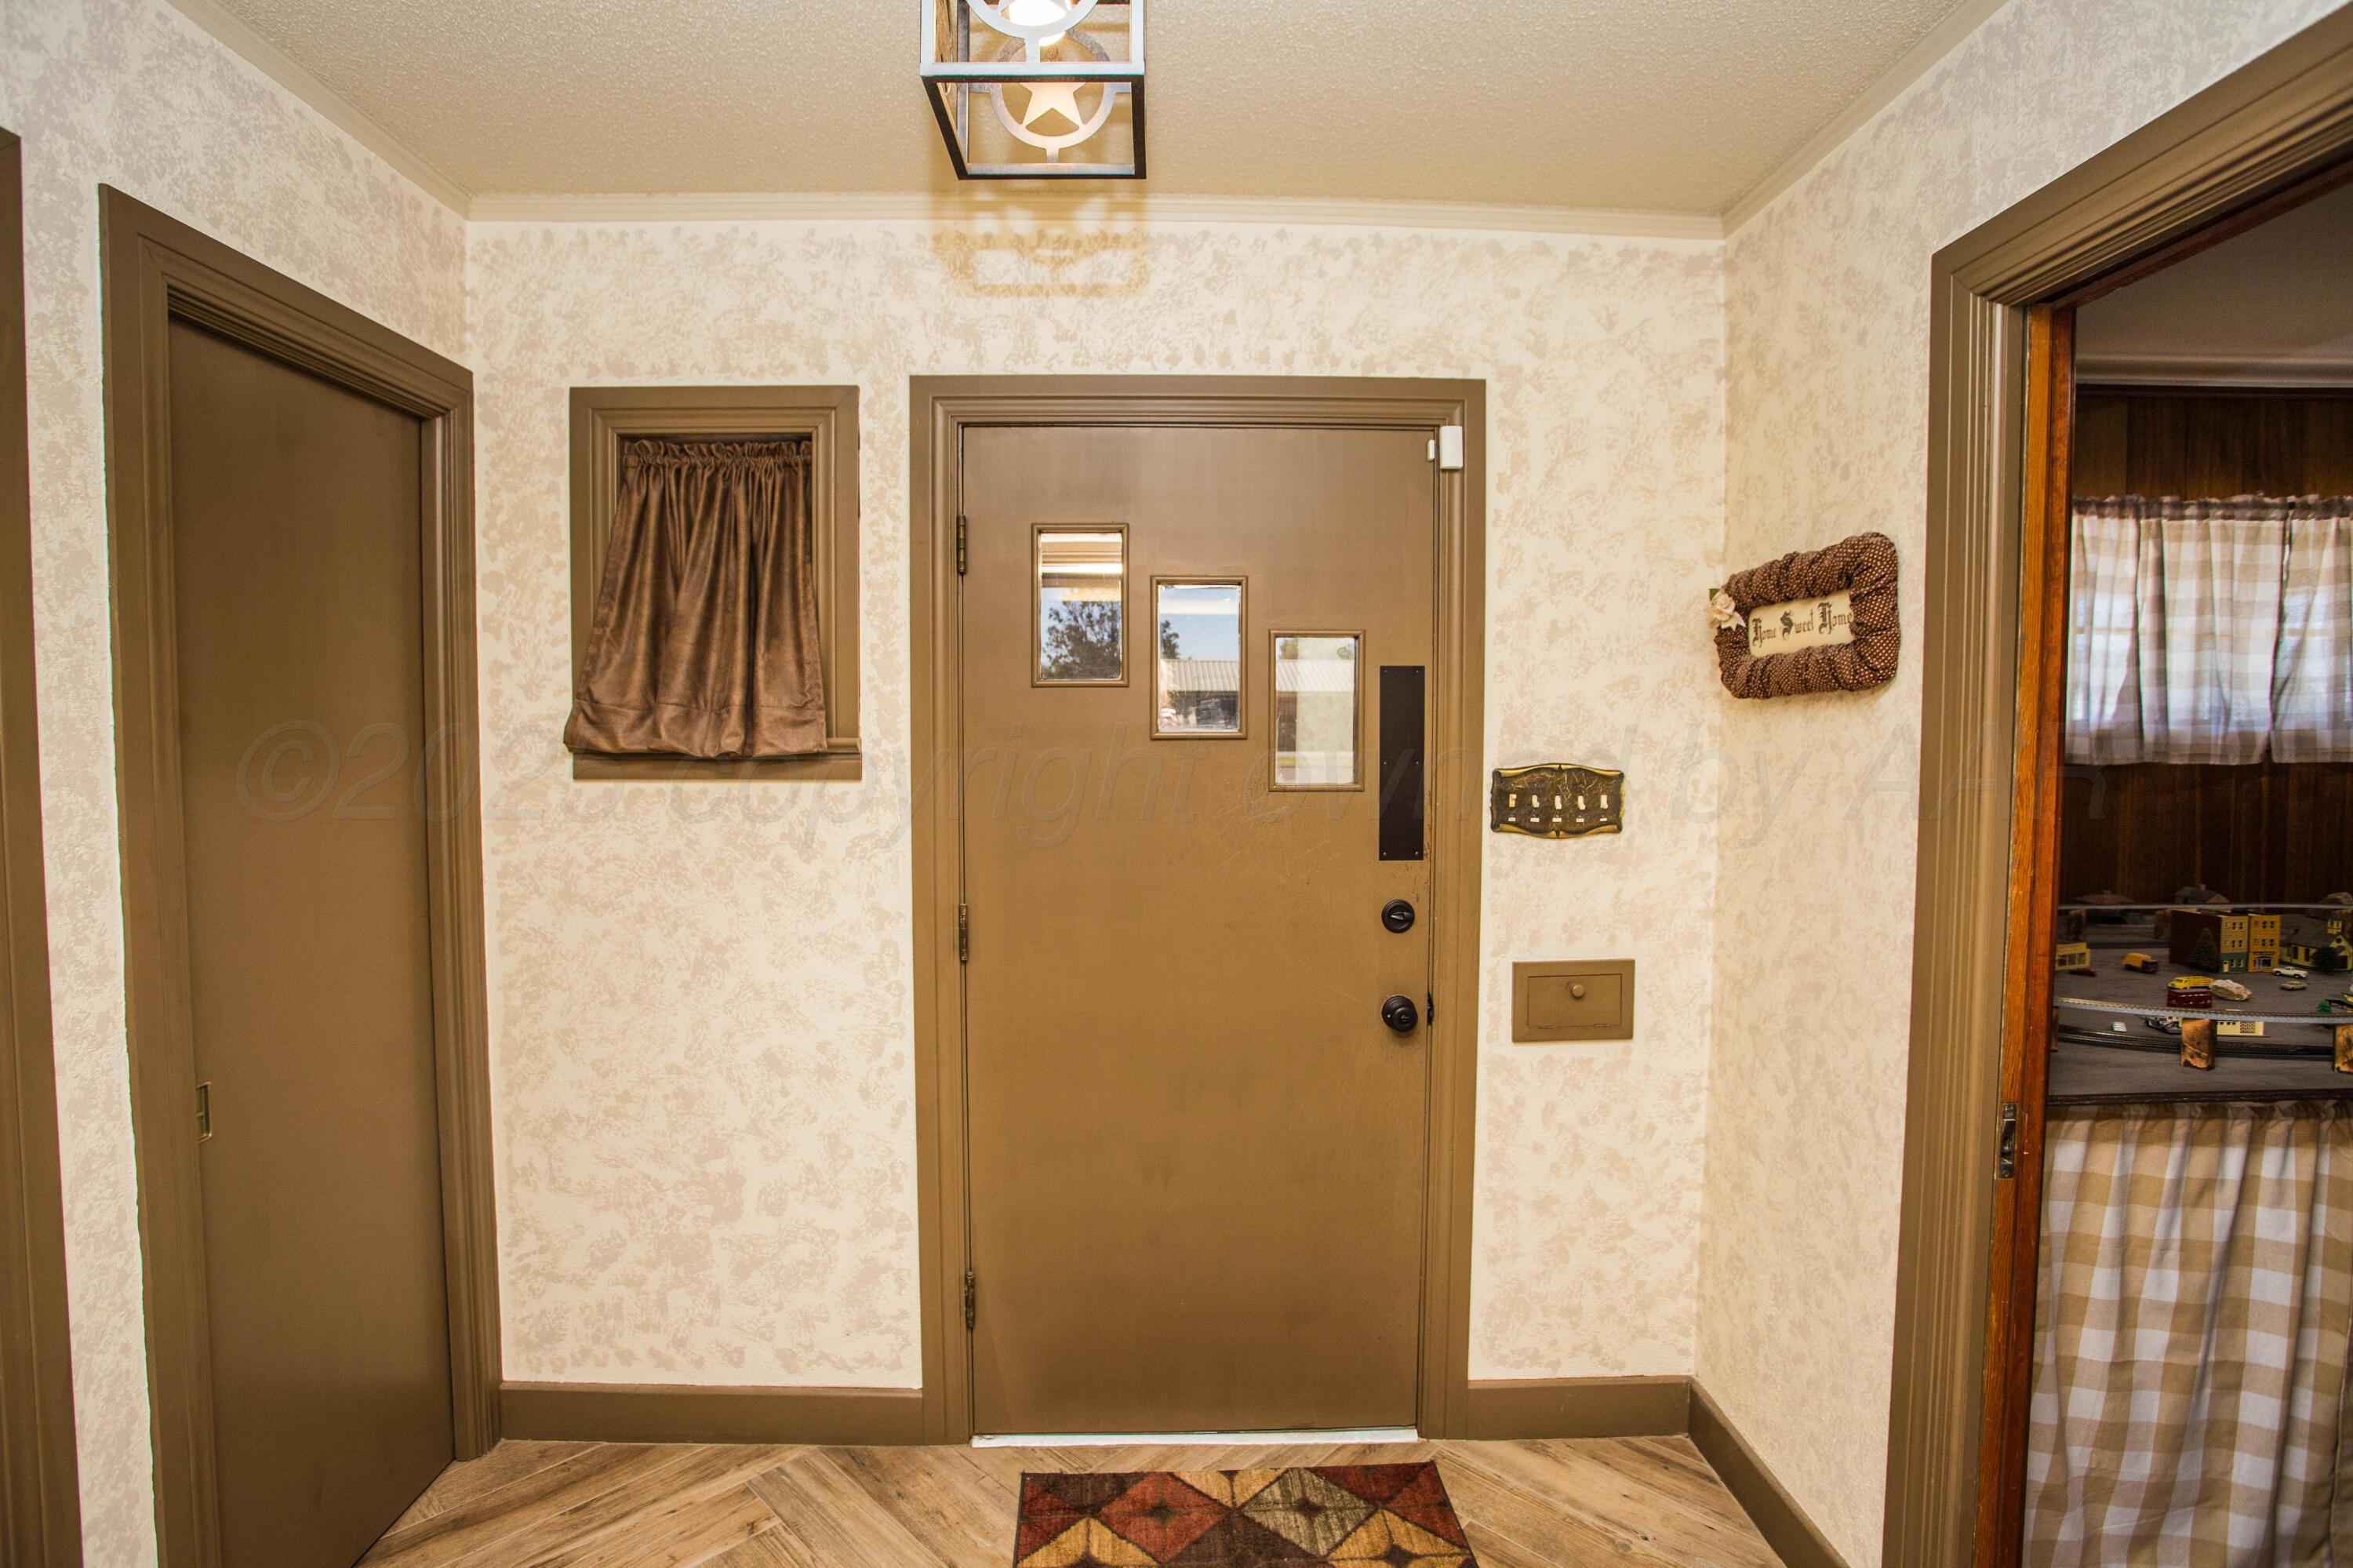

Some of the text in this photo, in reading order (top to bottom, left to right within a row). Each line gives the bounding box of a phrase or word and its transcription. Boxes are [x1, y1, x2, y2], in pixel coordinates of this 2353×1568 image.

[1752, 601, 1853, 648] Home Sweet Home
